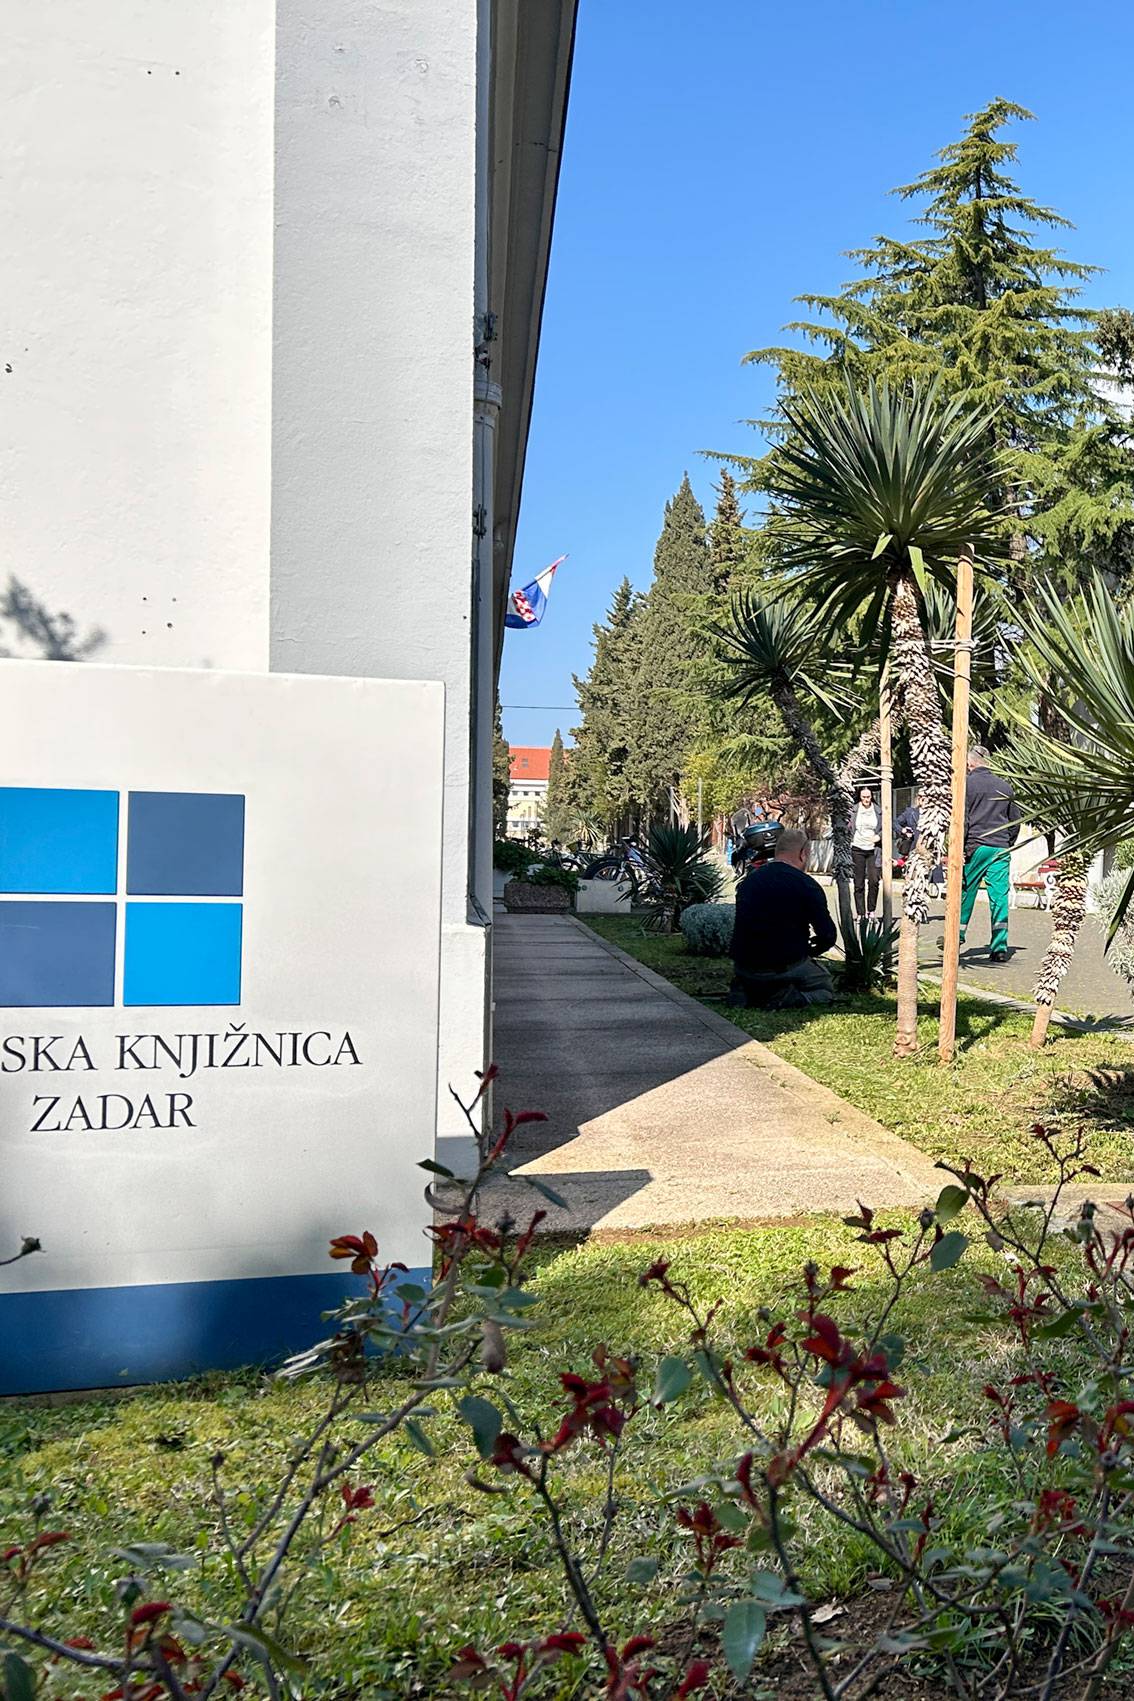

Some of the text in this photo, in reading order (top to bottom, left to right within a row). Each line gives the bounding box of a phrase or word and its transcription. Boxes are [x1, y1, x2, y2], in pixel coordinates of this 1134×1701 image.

[1, 1022, 363, 1078] SKA KNJIŽNICA
[30, 1093, 197, 1132] ZADAR
